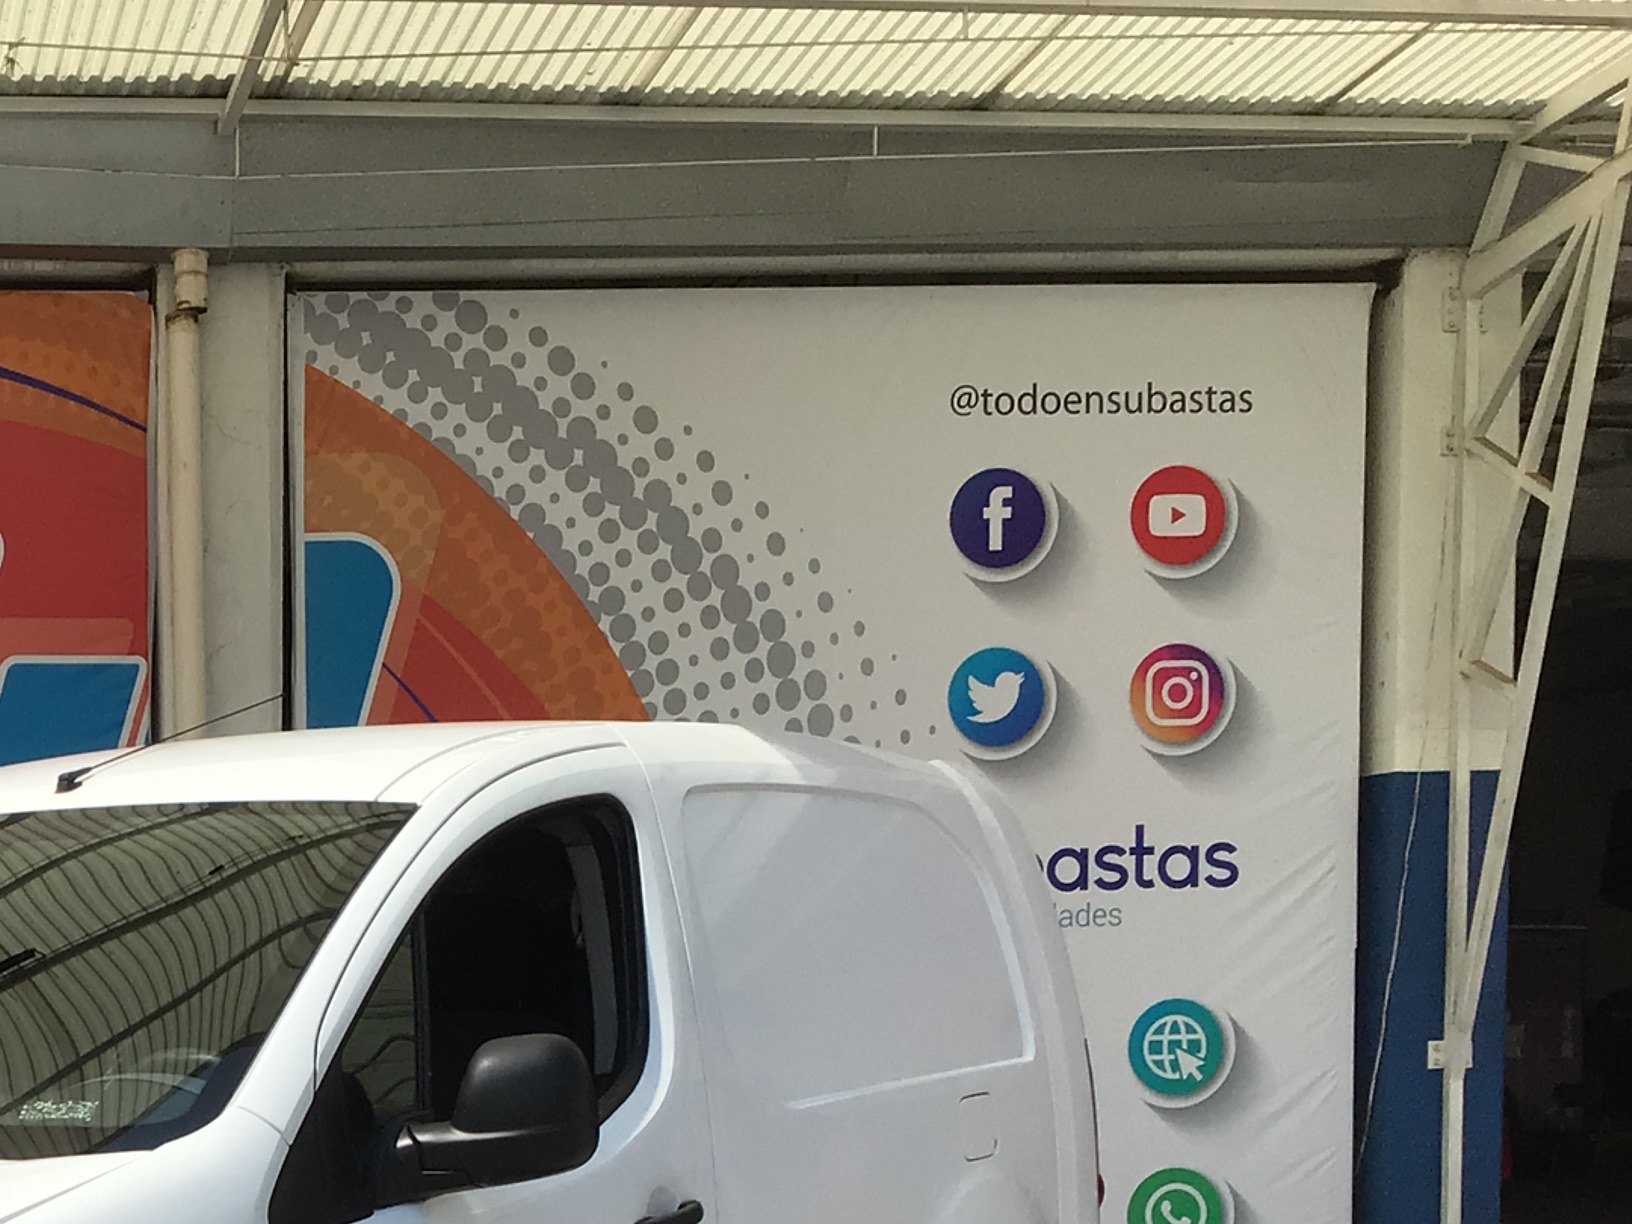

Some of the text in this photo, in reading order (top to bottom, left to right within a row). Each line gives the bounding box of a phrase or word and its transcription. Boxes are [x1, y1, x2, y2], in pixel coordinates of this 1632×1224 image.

[949, 382, 1253, 417] @todoensubastas
[1035, 824, 1240, 892] astas
[1053, 902, 1122, 928] ades
